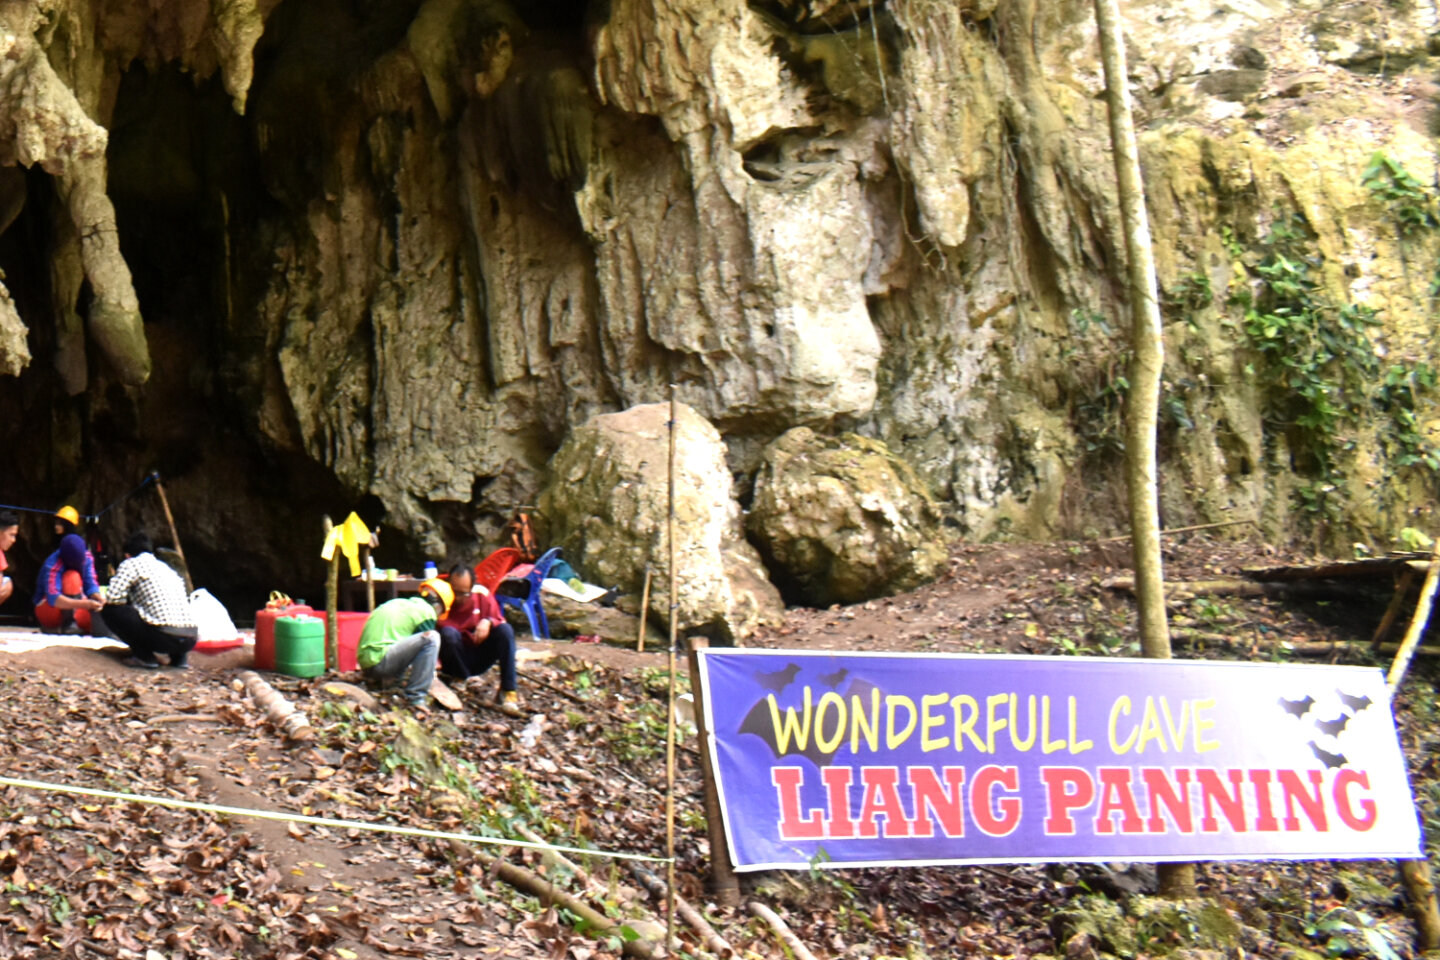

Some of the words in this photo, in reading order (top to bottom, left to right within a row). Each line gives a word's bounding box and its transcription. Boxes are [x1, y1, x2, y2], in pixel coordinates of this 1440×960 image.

[767, 686, 1092, 754] WONDERFULL
[1108, 695, 1220, 754] CAVE
[772, 766, 1021, 837] LIANG
[1042, 767, 1378, 835] PANNING
